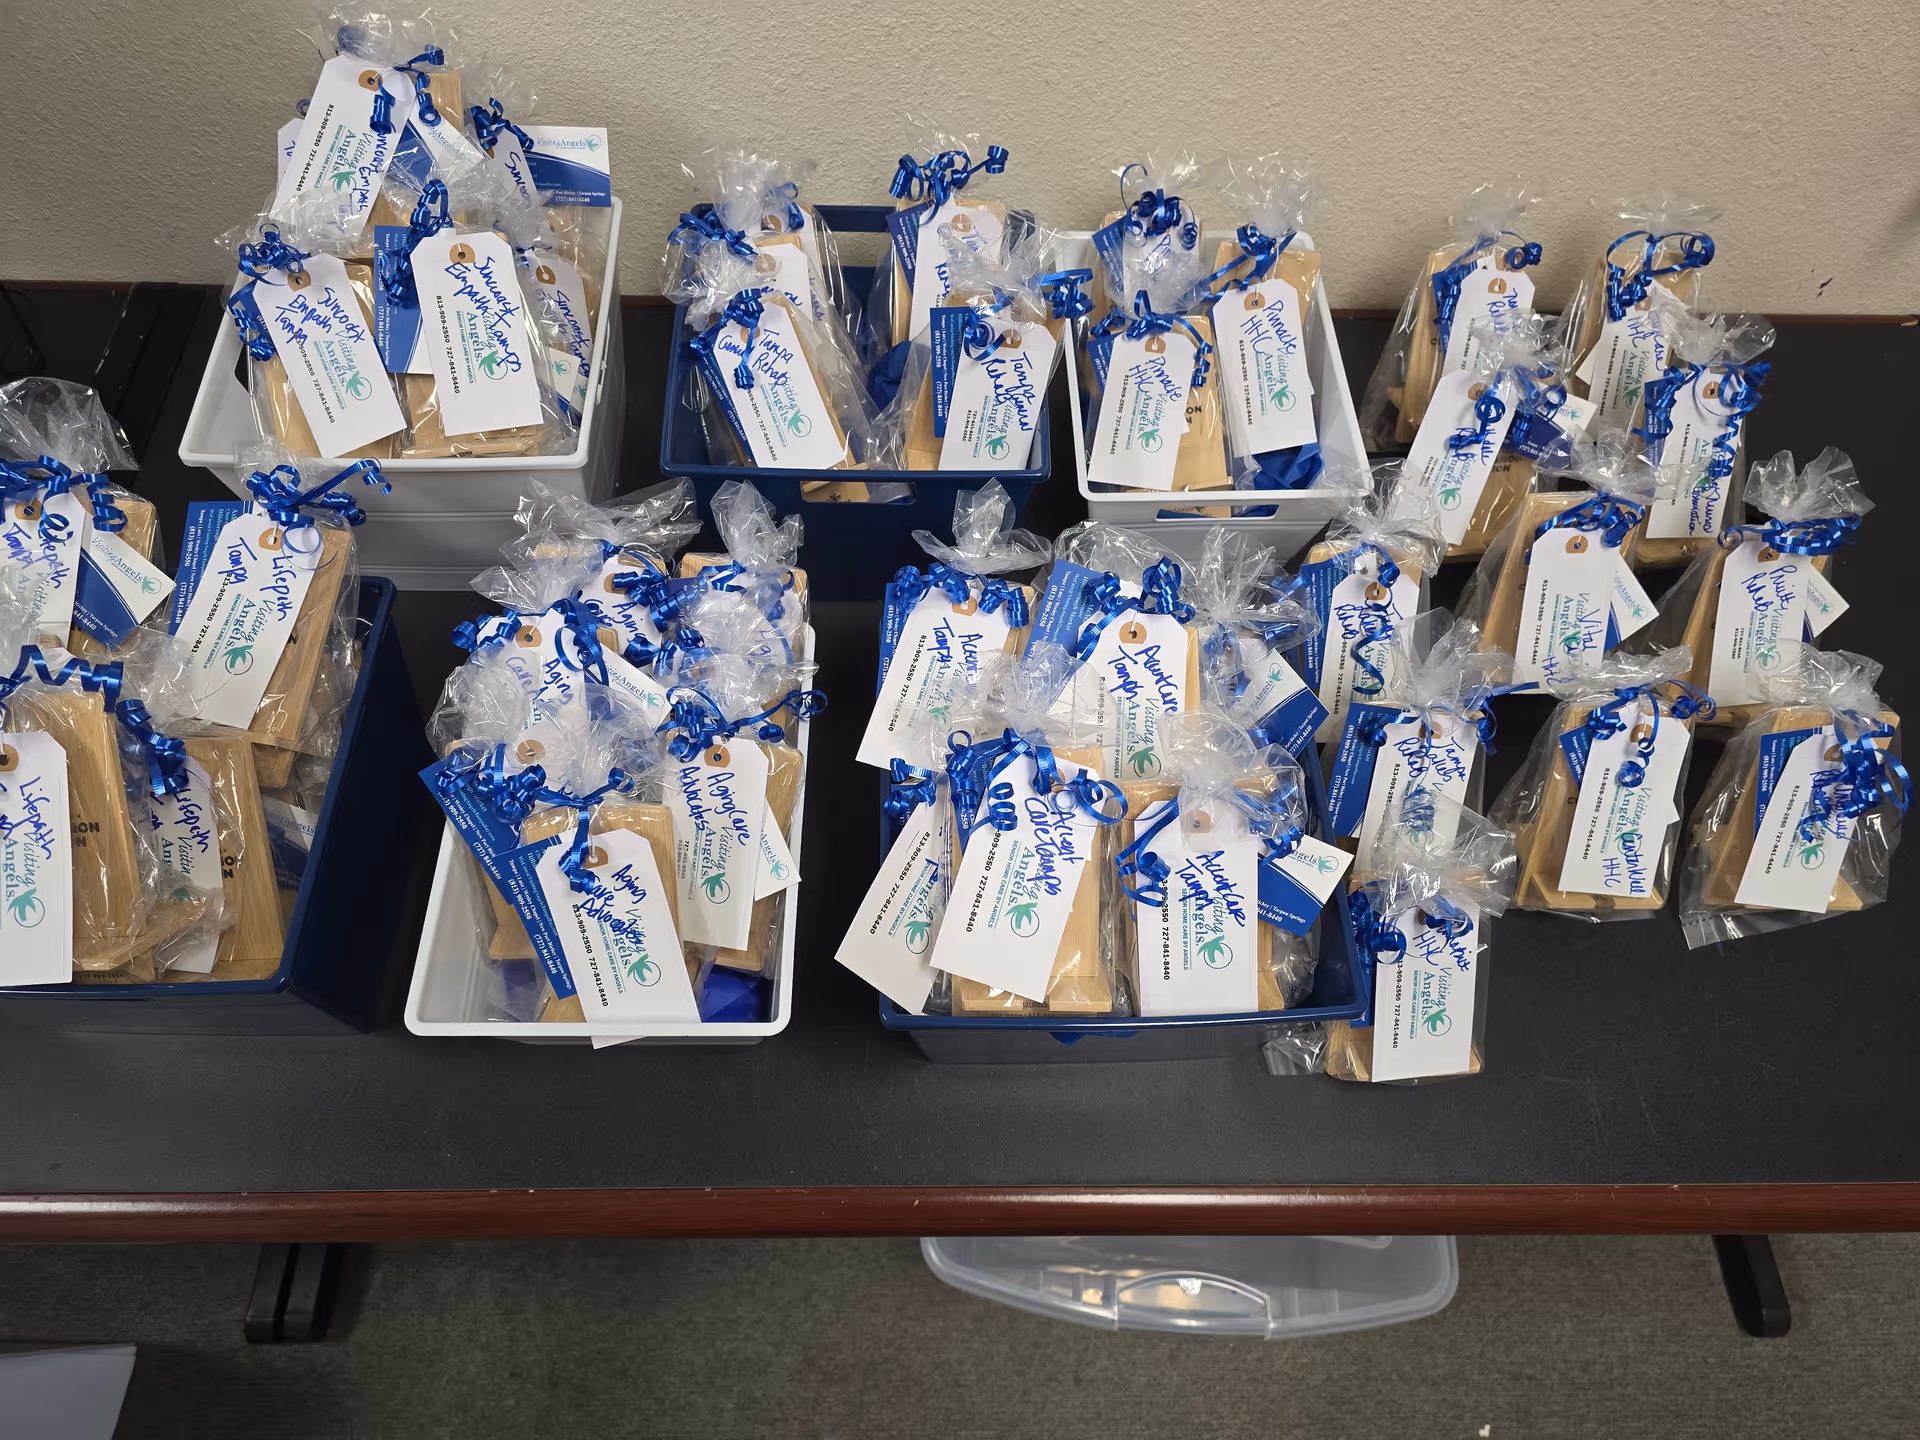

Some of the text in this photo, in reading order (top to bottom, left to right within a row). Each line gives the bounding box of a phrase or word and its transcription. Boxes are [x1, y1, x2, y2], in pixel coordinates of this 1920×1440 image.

[445, 262, 488, 315] Empath
[473, 256, 520, 317] Suncoast
[288, 294, 332, 333] Empath
[317, 287, 365, 343] Suncoast
[1239, 315, 1272, 354] HHC
[1262, 299, 1297, 355] Pinnacle
[758, 328, 794, 364] Tampa
[1011, 351, 1036, 405] Tampa
[1128, 365, 1154, 393] HHC
[217, 537, 258, 585] Tampa
[259, 554, 296, 622] Lifepath
[1579, 608, 1603, 652] Vital
[906, 634, 927, 682] 813-909-2550
[473, 842, 486, 857] (727)
[1602, 857, 1621, 888] HHC
[611, 863, 647, 905] Aging
[869, 831, 931, 936] 813-909-2550 727-841-8440
[965, 875, 989, 933] 727-841-8440
[508, 879, 557, 974] (813) 909-2550 (727) 841-8440
[572, 903, 608, 1007] 813-909-2550 727-841-8440
[1161, 926, 1171, 981] 727-841-8440
[1392, 1004, 1401, 1048] 727-841-8440
